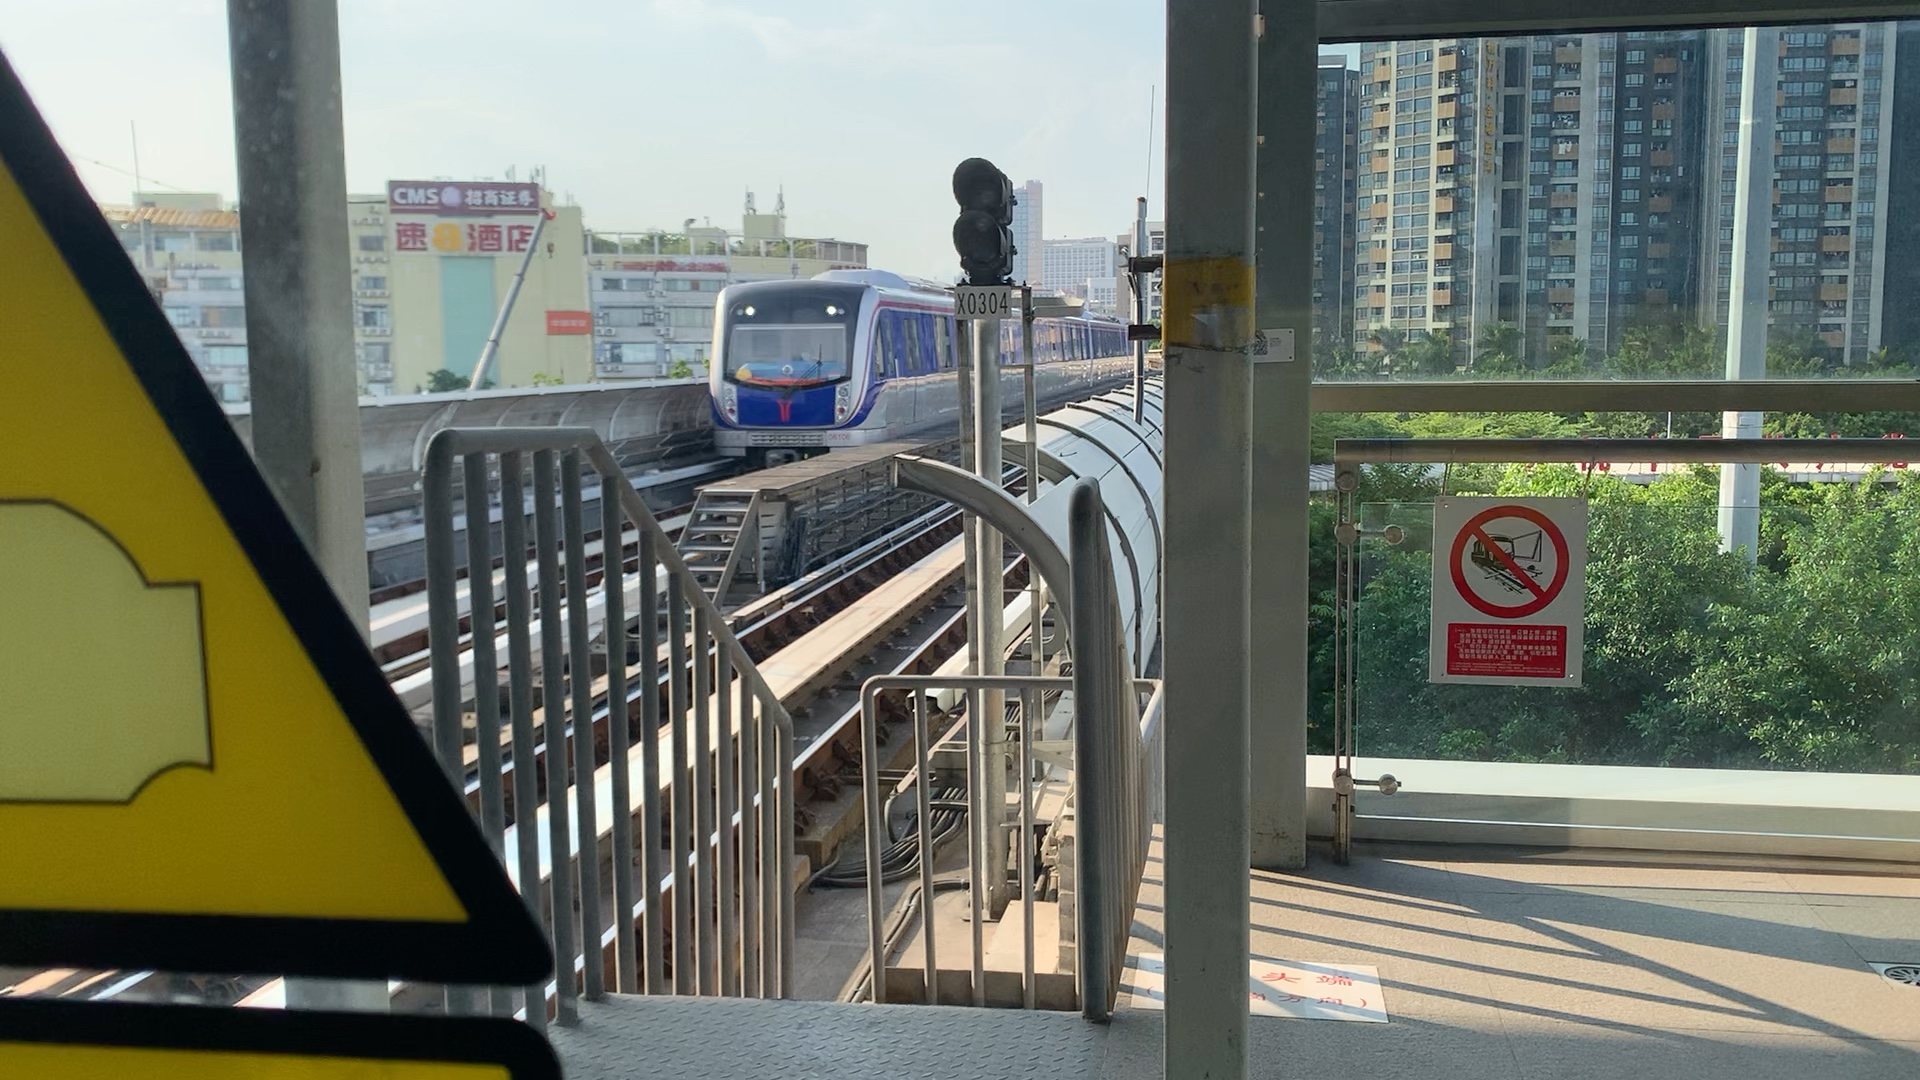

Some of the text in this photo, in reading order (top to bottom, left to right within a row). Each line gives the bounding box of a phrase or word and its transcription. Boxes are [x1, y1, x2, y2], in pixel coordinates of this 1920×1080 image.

[393, 187, 440, 204] CMS
[464, 189, 534, 206] 招商证券
[957, 292, 1008, 314] X0304
